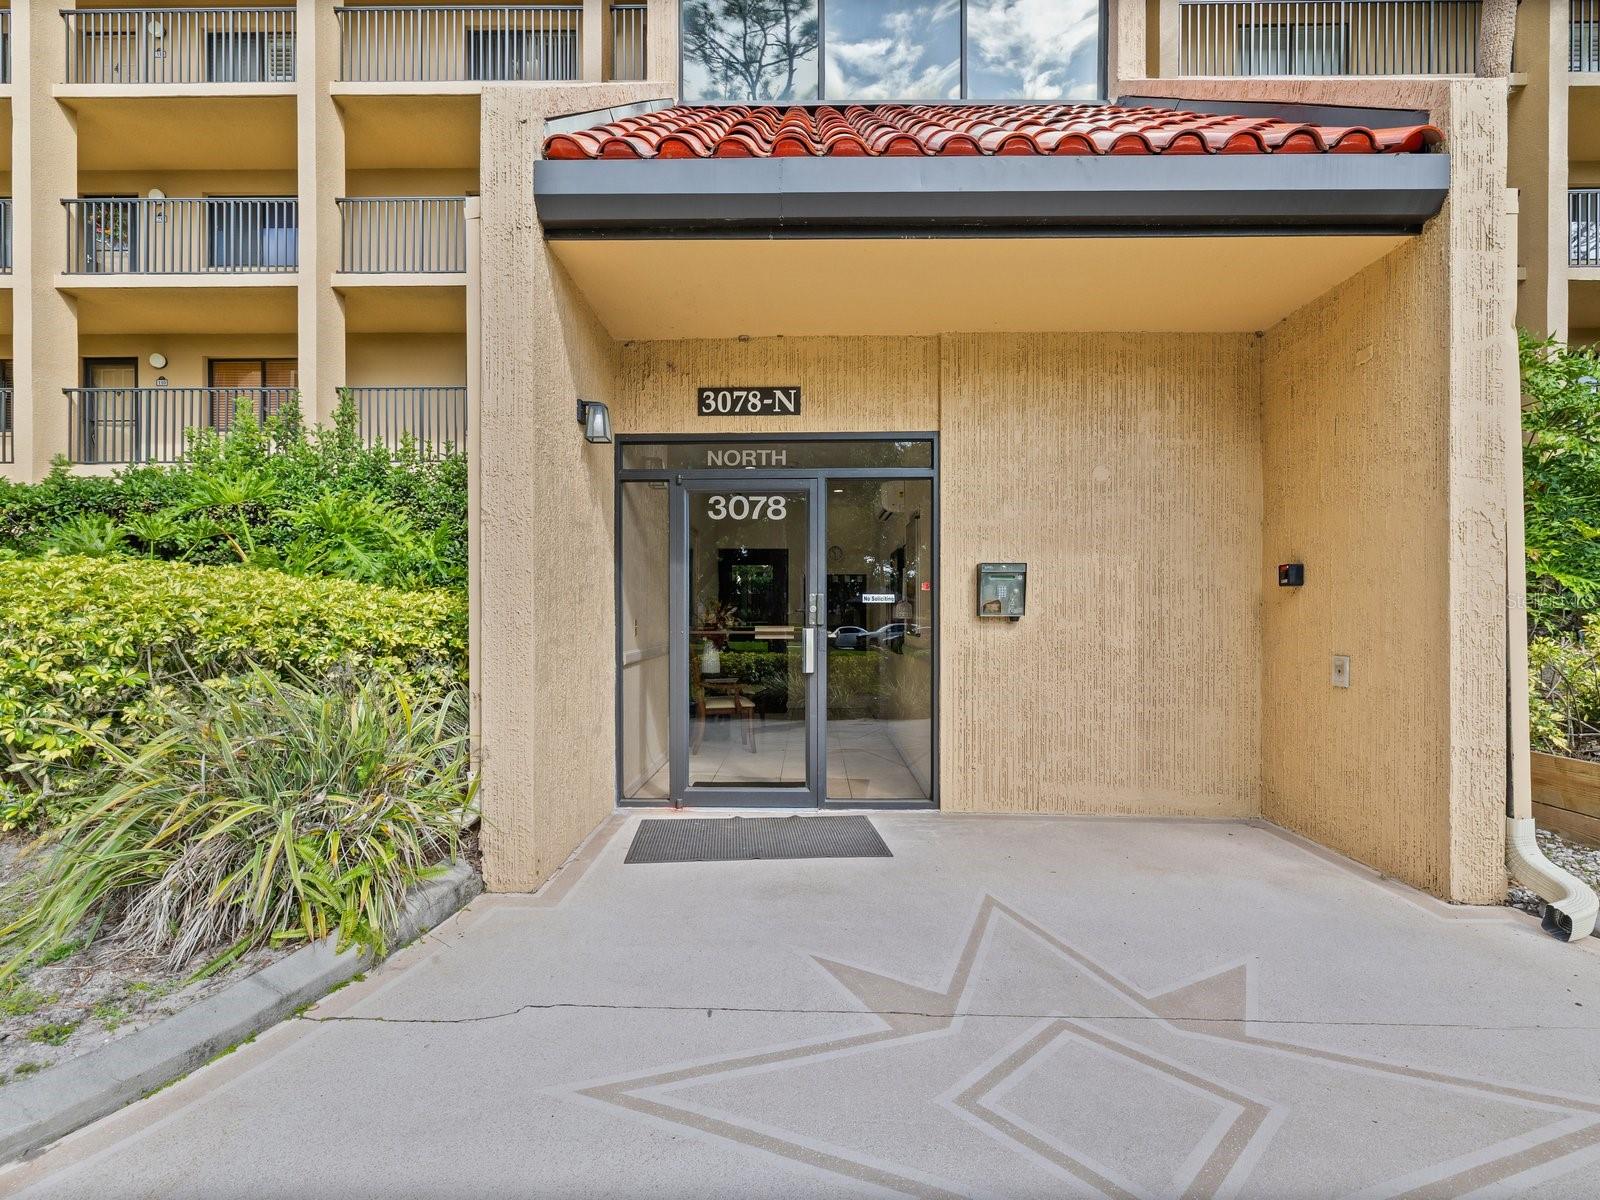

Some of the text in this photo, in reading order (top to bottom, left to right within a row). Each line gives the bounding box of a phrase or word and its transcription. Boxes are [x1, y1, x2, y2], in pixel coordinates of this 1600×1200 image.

[702, 390, 796, 412] 3078-N
[707, 449, 787, 466] NORTH
[707, 495, 787, 520] 3078
